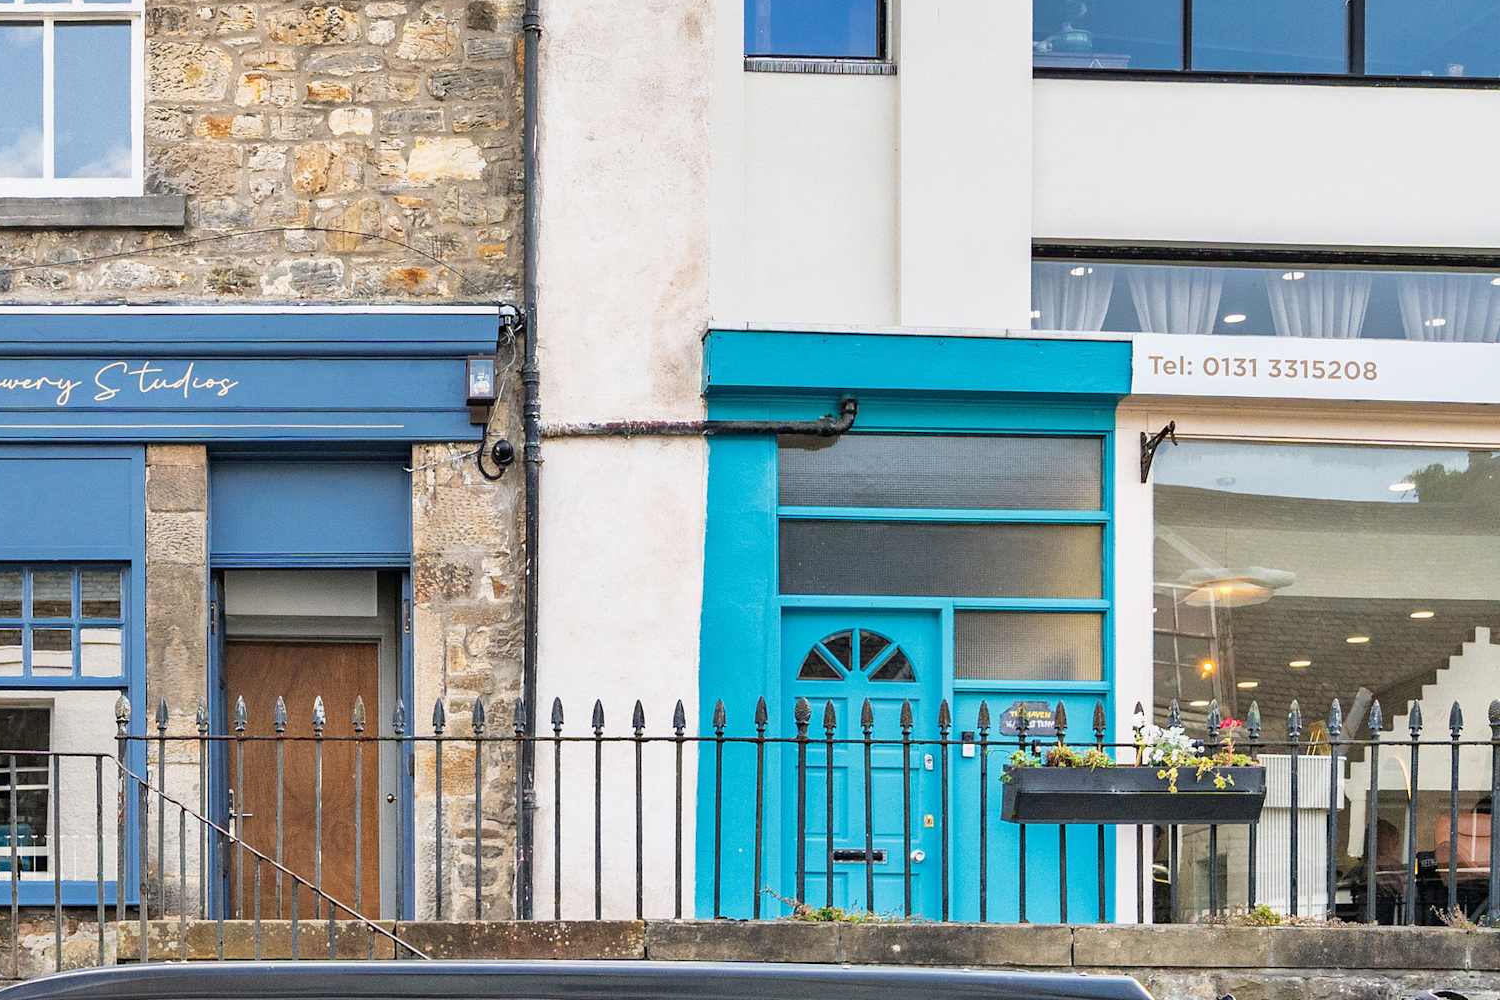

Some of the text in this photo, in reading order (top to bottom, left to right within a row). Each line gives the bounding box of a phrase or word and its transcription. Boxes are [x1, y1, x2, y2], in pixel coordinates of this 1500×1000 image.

[92, 361, 239, 401] Studios
[1148, 355, 1378, 381] Tel: 0131 3315208
